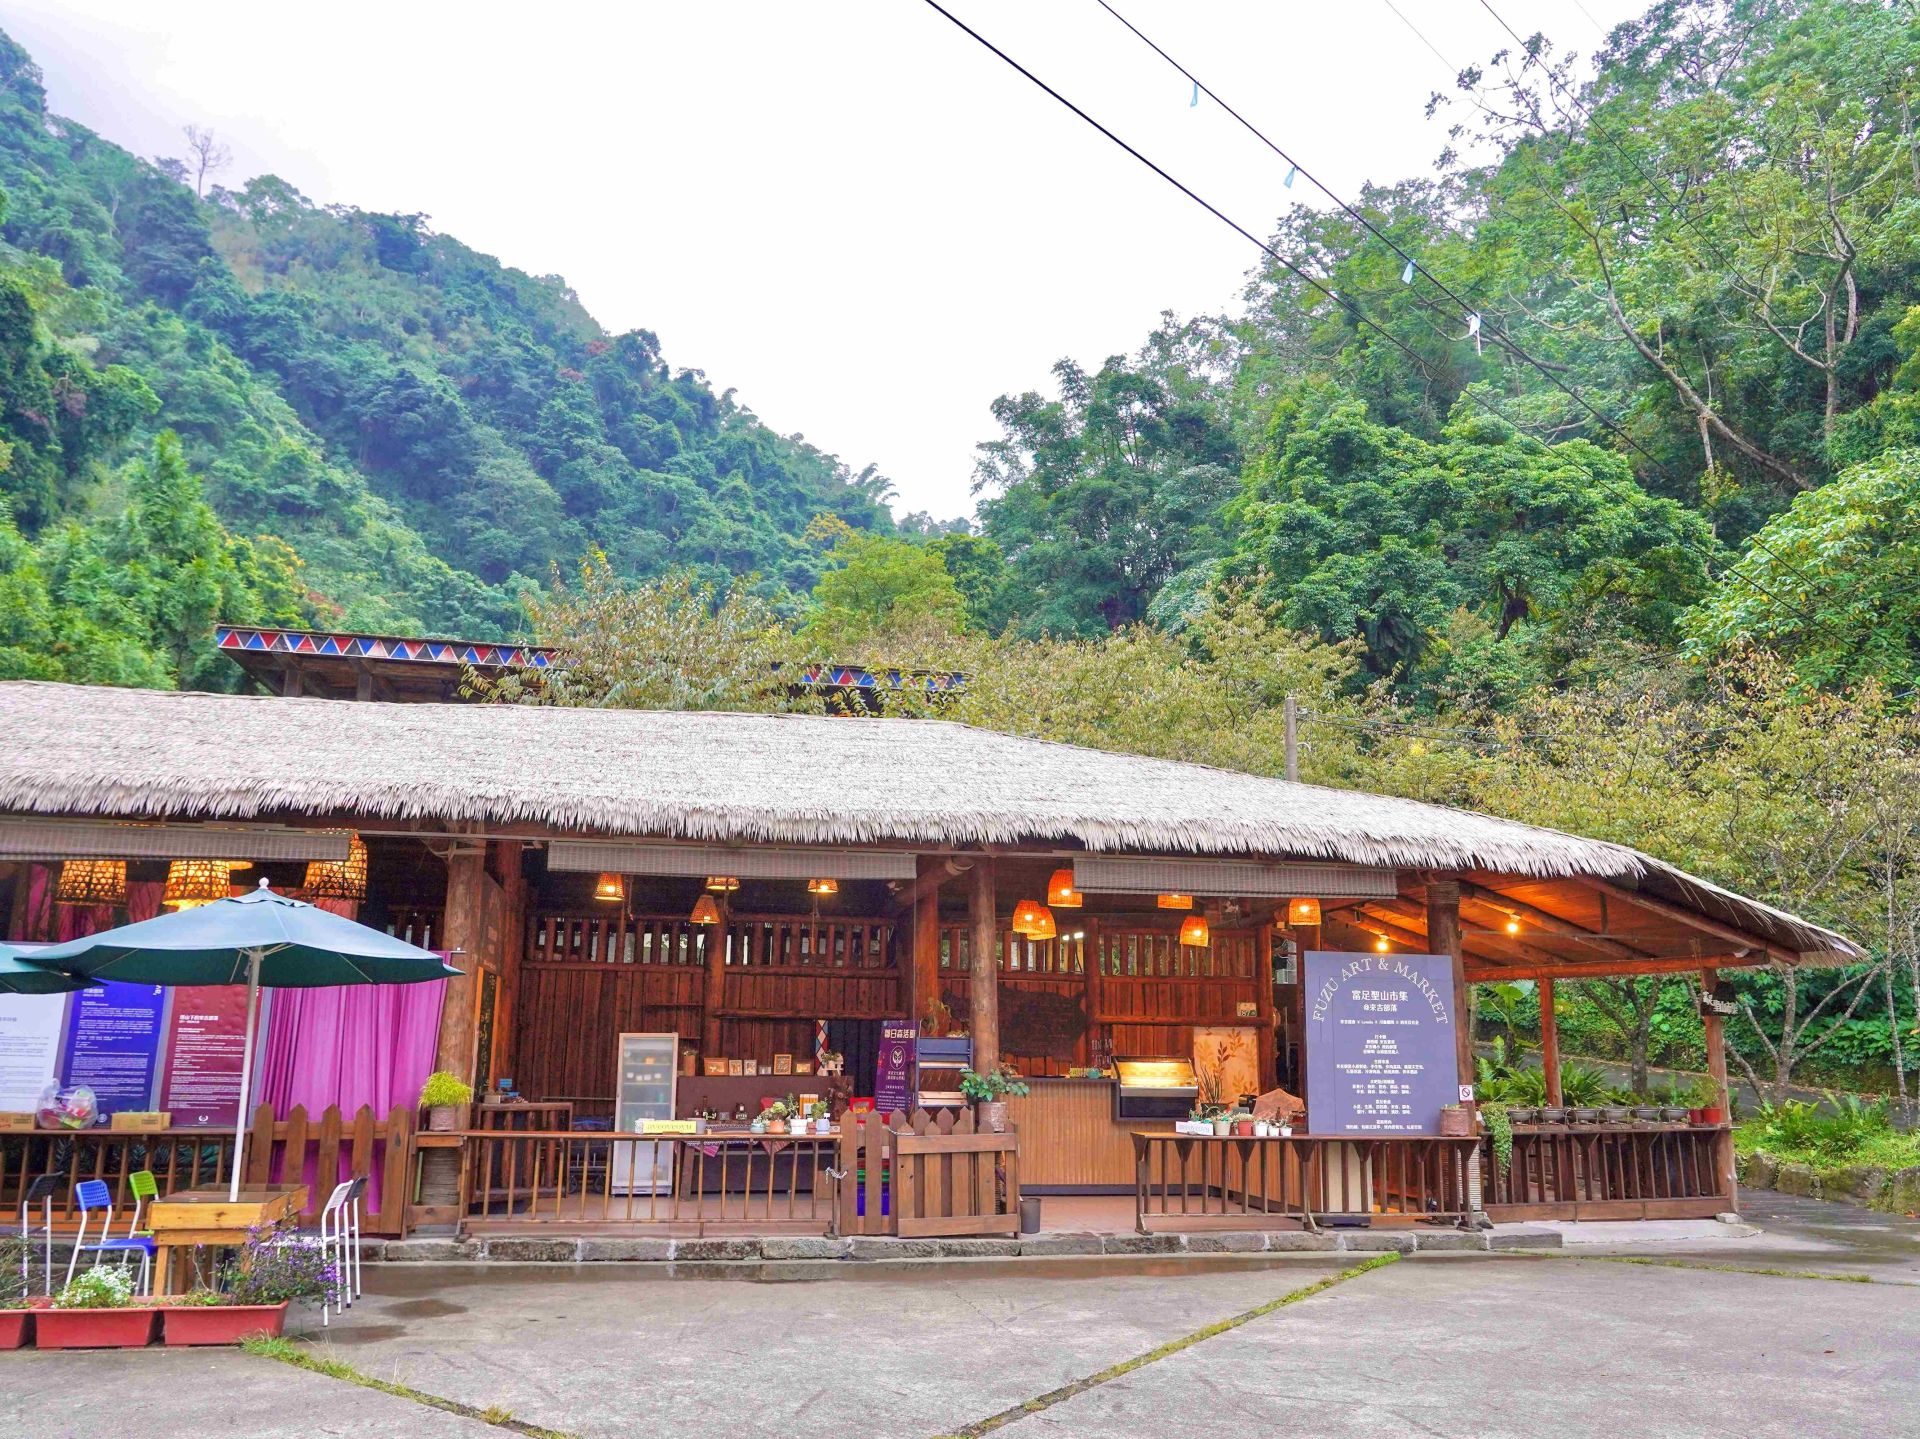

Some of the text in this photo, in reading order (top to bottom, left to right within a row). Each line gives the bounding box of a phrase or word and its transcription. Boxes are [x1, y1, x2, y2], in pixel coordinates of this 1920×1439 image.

[1313, 957, 1449, 1024] FUZU ART & MARKET
